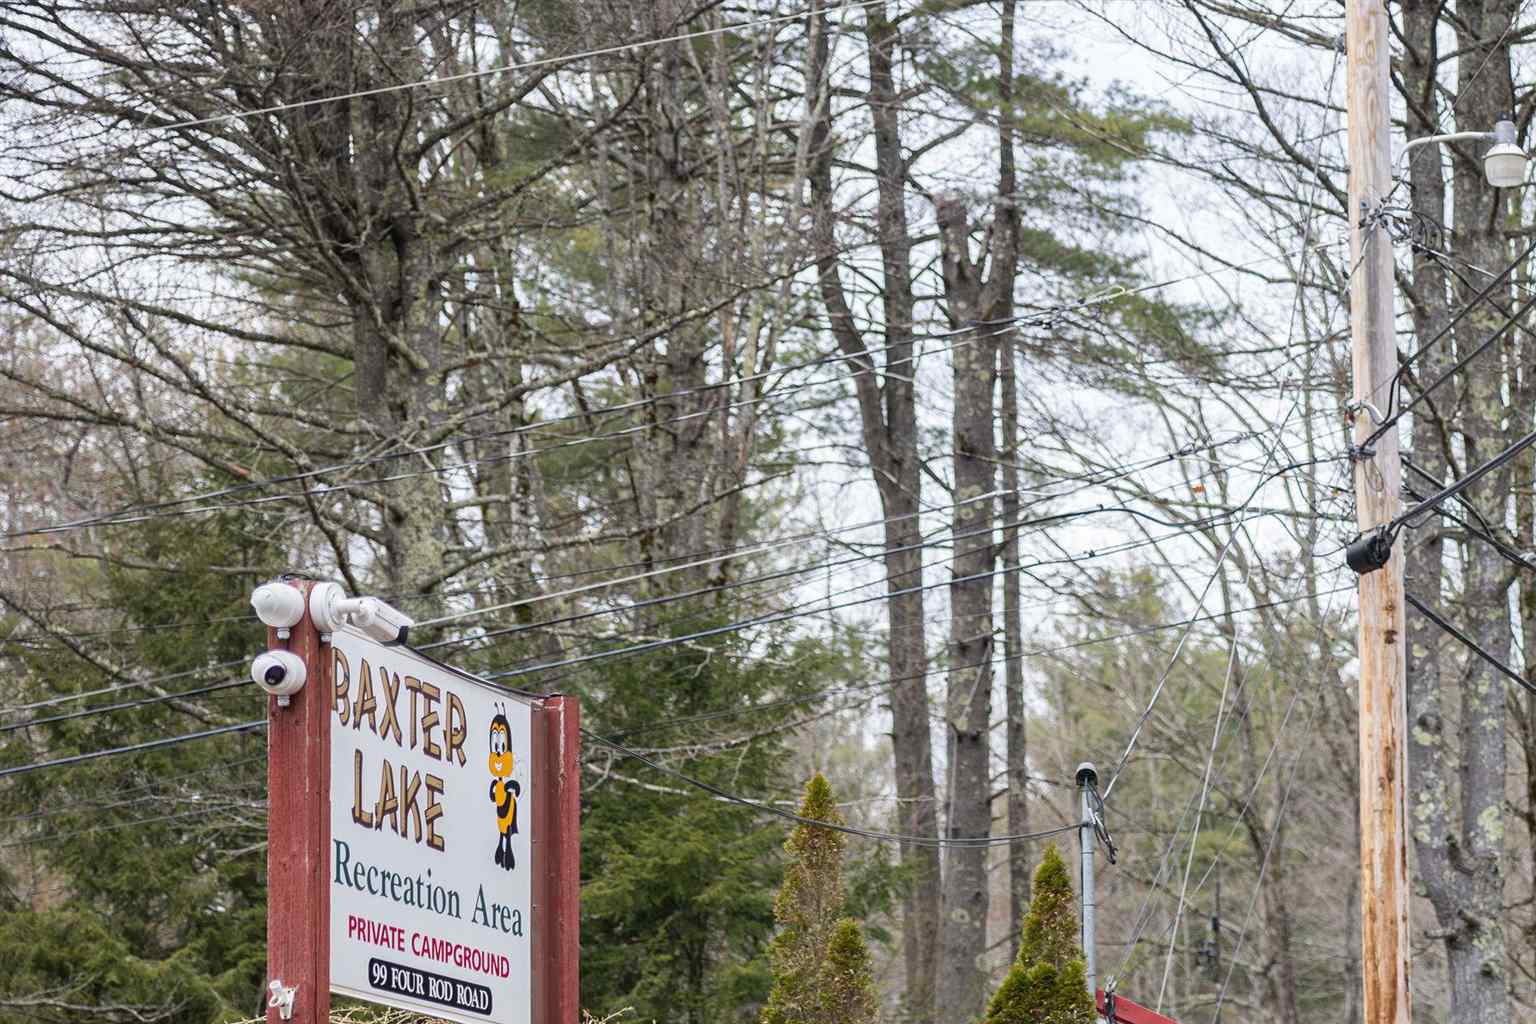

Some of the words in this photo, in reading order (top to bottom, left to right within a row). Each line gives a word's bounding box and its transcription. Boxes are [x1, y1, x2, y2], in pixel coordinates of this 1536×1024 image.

[332, 647, 467, 768] BAXTER
[352, 748, 445, 852] LAKE
[333, 839, 462, 920] Recreation
[472, 883, 523, 937] Area
[348, 915, 405, 952] PRIVATE
[411, 932, 510, 978] CAMPGROUND
[372, 963, 387, 984] 99
[391, 967, 425, 996] FOUR
[428, 976, 453, 1003] ROD
[456, 983, 489, 1010] ROAD
